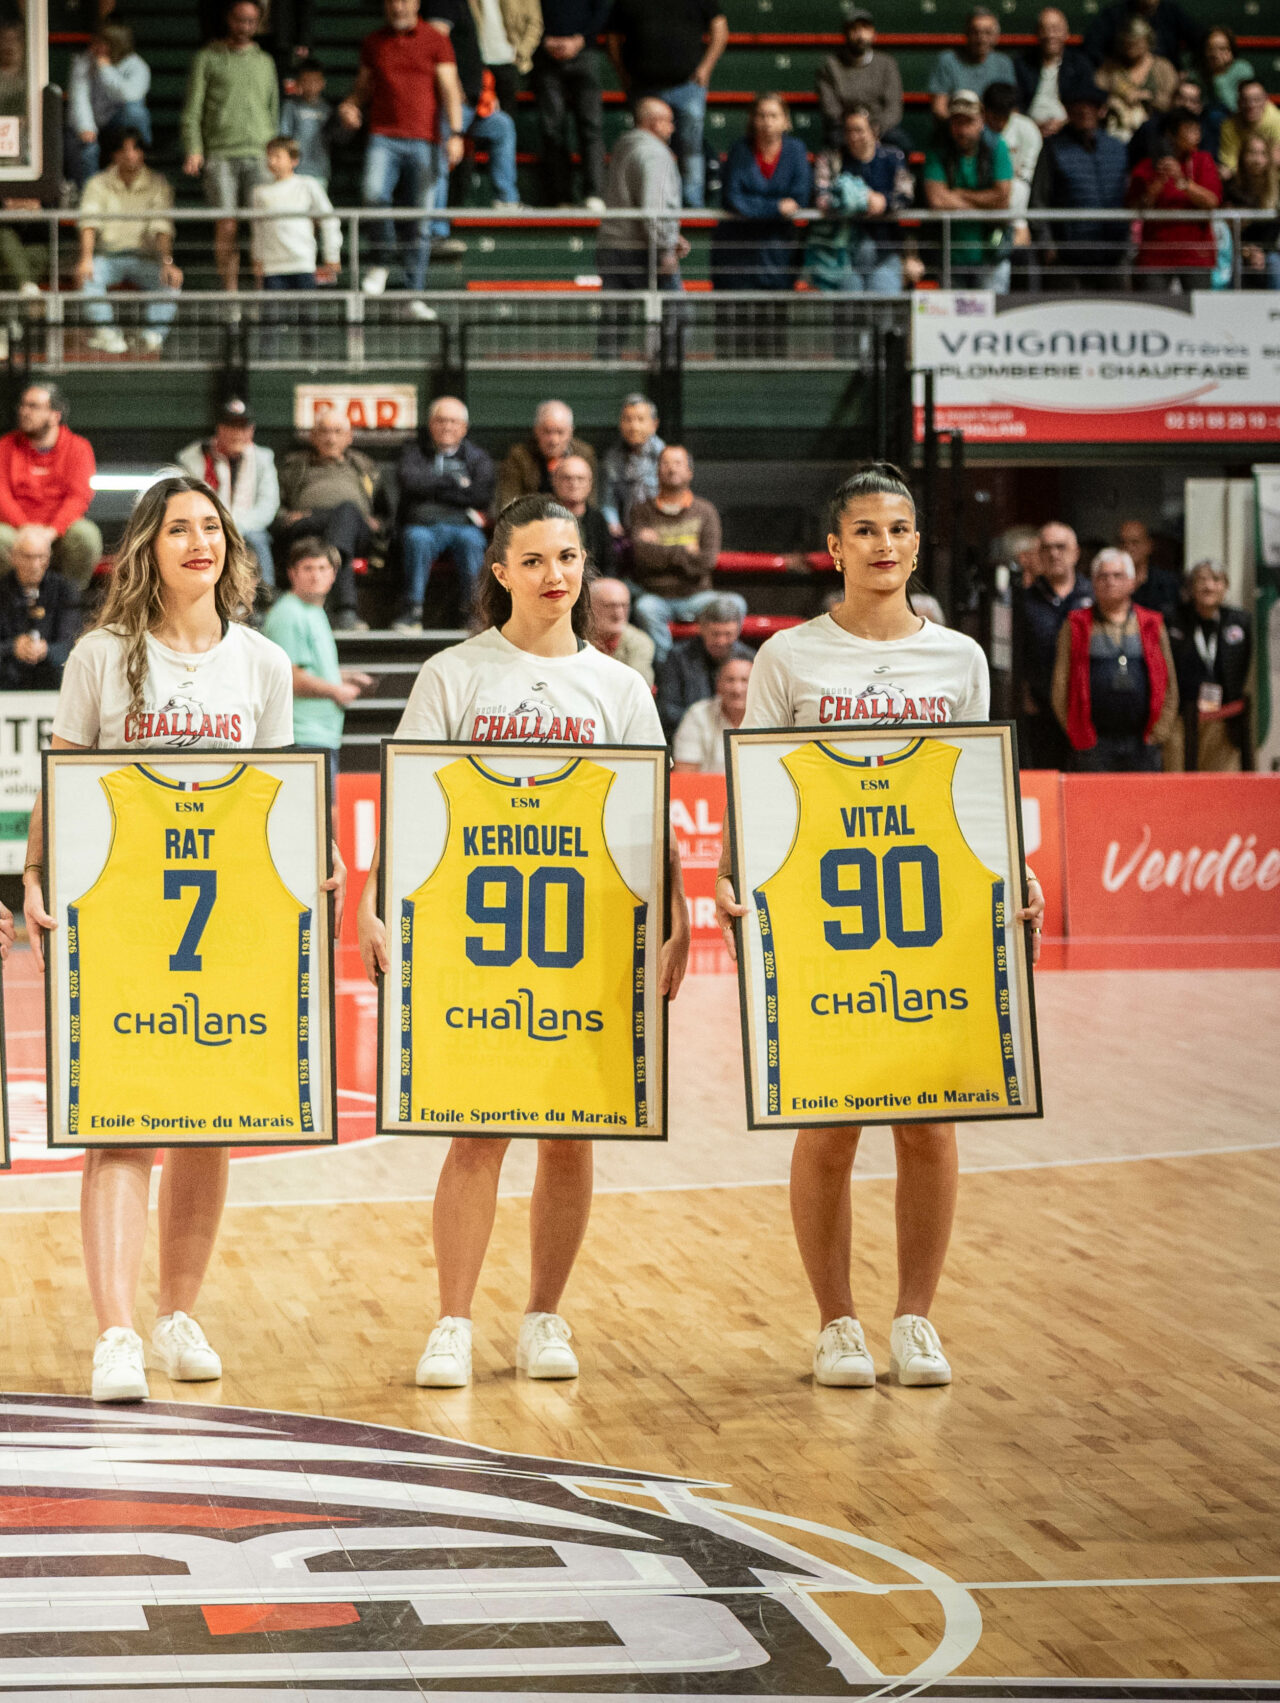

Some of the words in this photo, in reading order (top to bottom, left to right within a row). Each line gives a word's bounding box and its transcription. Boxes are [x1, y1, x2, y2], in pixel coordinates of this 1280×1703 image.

[938, 330, 1172, 357] VRIGNAUD
[936, 362, 1081, 380] PLOMBERIE
[1099, 362, 1251, 380] CHAUFFAGE
[818, 695, 948, 724] CHALLANS
[124, 712, 242, 743] CHALLANS
[471, 715, 596, 744] CHALLANS
[860, 779, 890, 791] ESM
[175, 802, 204, 813] ESM
[511, 797, 540, 809] ESM
[839, 804, 916, 838] VITAL
[165, 828, 216, 860] RAT
[463, 824, 589, 858] KERIQUEL
[1102, 823, 1280, 898] Vendée
[819, 844, 943, 951] 90
[163, 869, 217, 972] 7
[465, 865, 585, 969] 90
[758, 908, 771, 936] 2026
[995, 901, 1004, 929] 1936
[68, 926, 78, 954] 2026
[301, 930, 311, 956] 1936
[401, 916, 411, 944] 2026
[636, 924, 646, 950] 1936
[764, 951, 775, 979] 2026
[996, 945, 1006, 972] 1936
[70, 970, 79, 999] 2026
[300, 973, 310, 999] 1936
[402, 960, 411, 989] 2026
[635, 967, 644, 993] 1936
[767, 995, 777, 1023] 2026
[1000, 989, 1009, 1016] 1936
[71, 1014, 80, 1043] 2026
[300, 1015, 309, 1042] 1936
[401, 1004, 410, 1032] 2026
[635, 1011, 644, 1038] 1936
[768, 1039, 778, 1067] 2026
[1002, 1033, 1014, 1060] 1936
[70, 1059, 80, 1087] 2026
[300, 1058, 309, 1086] 1936
[401, 1048, 410, 1076] 2026
[636, 1055, 645, 1084] 1936
[400, 1091, 410, 1120] 2026
[768, 1083, 778, 1112] 2026
[792, 1095, 839, 1110] Etoile
[844, 1093, 912, 1110] Sportive
[917, 1091, 938, 1105] du
[943, 1089, 1000, 1103] Marais
[70, 1103, 79, 1131] 2026
[91, 1115, 135, 1129] Etoile
[141, 1115, 207, 1130] Sportive
[212, 1115, 233, 1128] du
[239, 1114, 294, 1128] Marais
[420, 1108, 465, 1123] Etoile
[470, 1108, 539, 1124] Sportive
[544, 1109, 565, 1122] du
[571, 1109, 628, 1126] Marais
